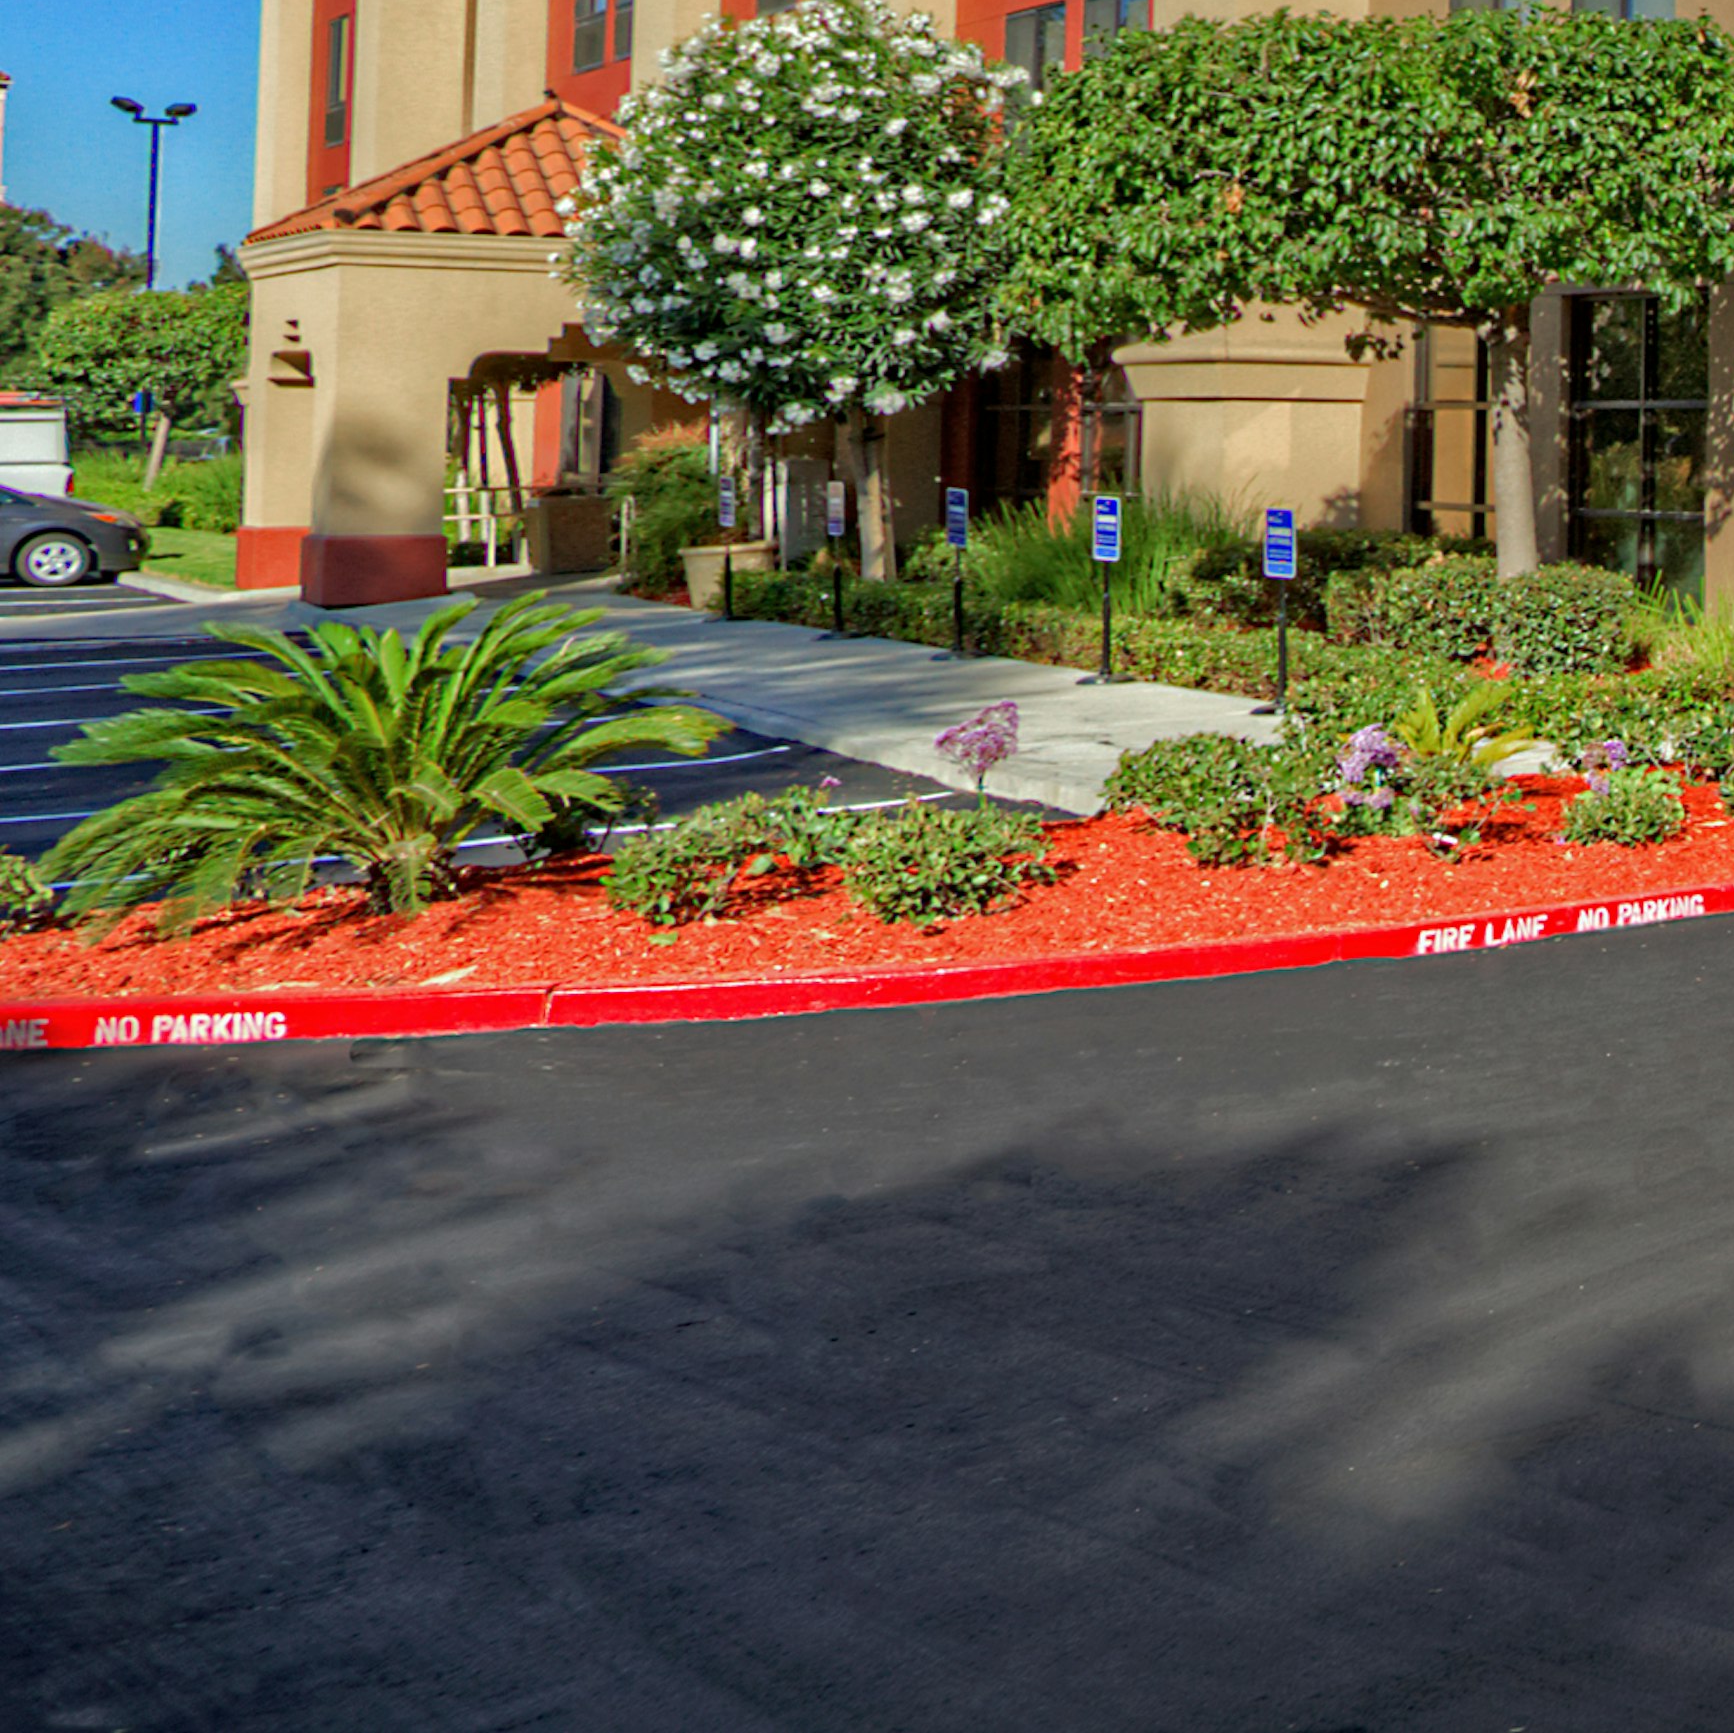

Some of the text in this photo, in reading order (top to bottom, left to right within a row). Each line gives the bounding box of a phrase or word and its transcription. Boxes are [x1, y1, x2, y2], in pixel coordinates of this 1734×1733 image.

[1576, 907, 1609, 932] NO
[1616, 894, 1706, 927] PARKING
[94, 1016, 139, 1044] NO
[151, 1012, 286, 1043] PARKING
